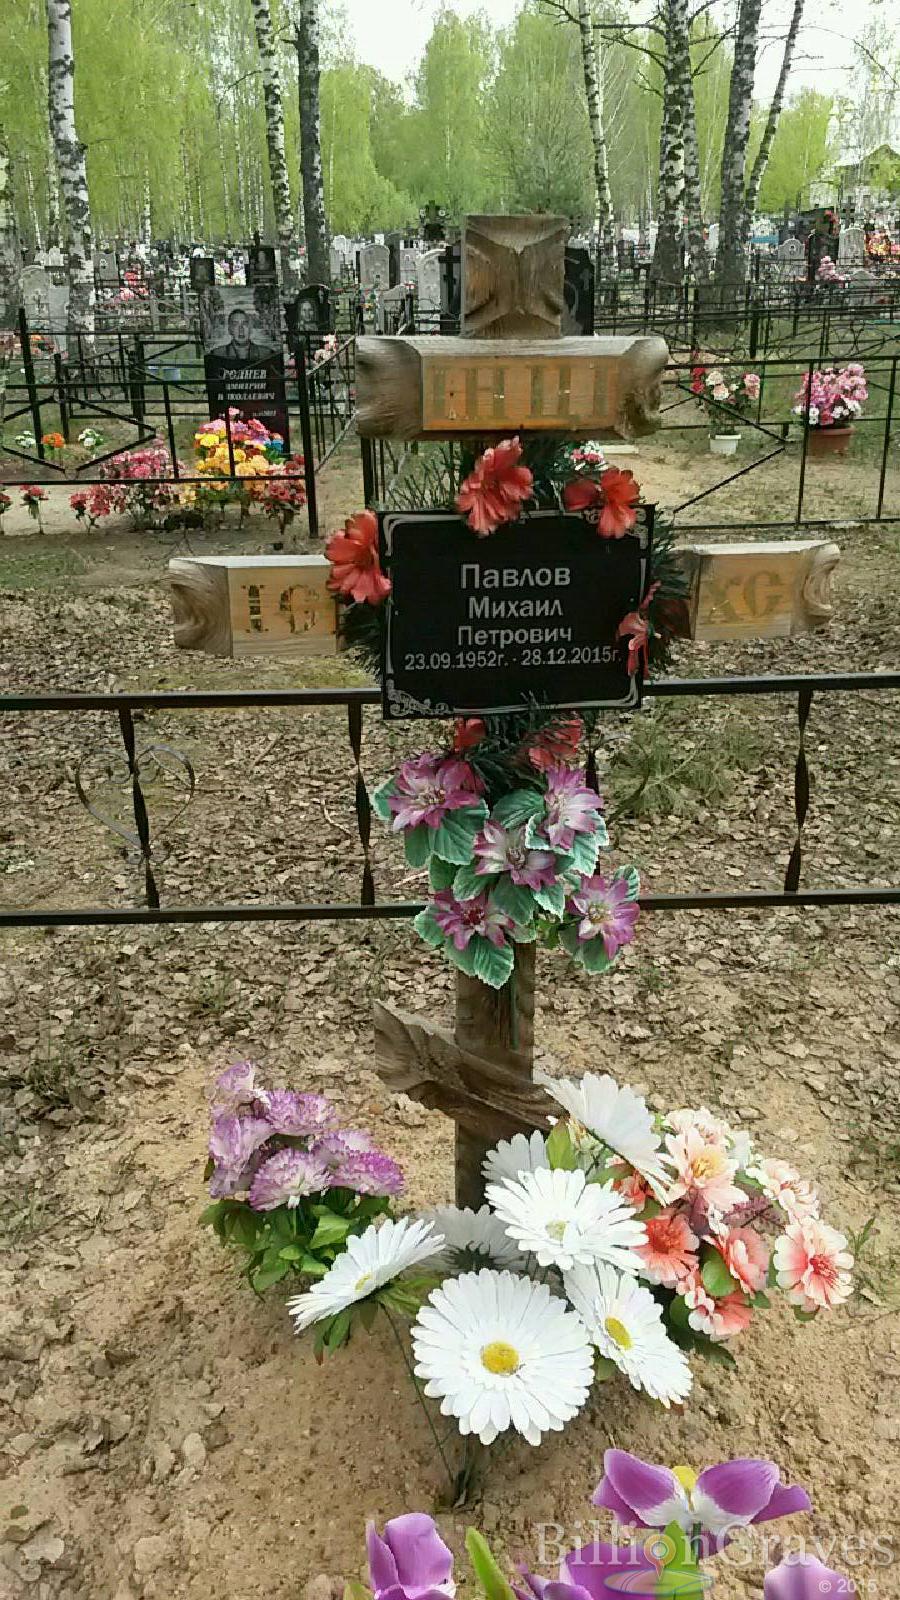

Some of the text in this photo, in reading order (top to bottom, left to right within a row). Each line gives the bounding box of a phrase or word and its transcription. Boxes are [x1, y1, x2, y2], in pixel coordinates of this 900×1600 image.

[460, 563, 572, 589] Павлов
[468, 596, 564, 619] Михаил
[458, 625, 572, 649] Петрович
[404, 651, 509, 670] 23.09.1952г.
[520, 645, 622, 666] 28.12.2015г.
